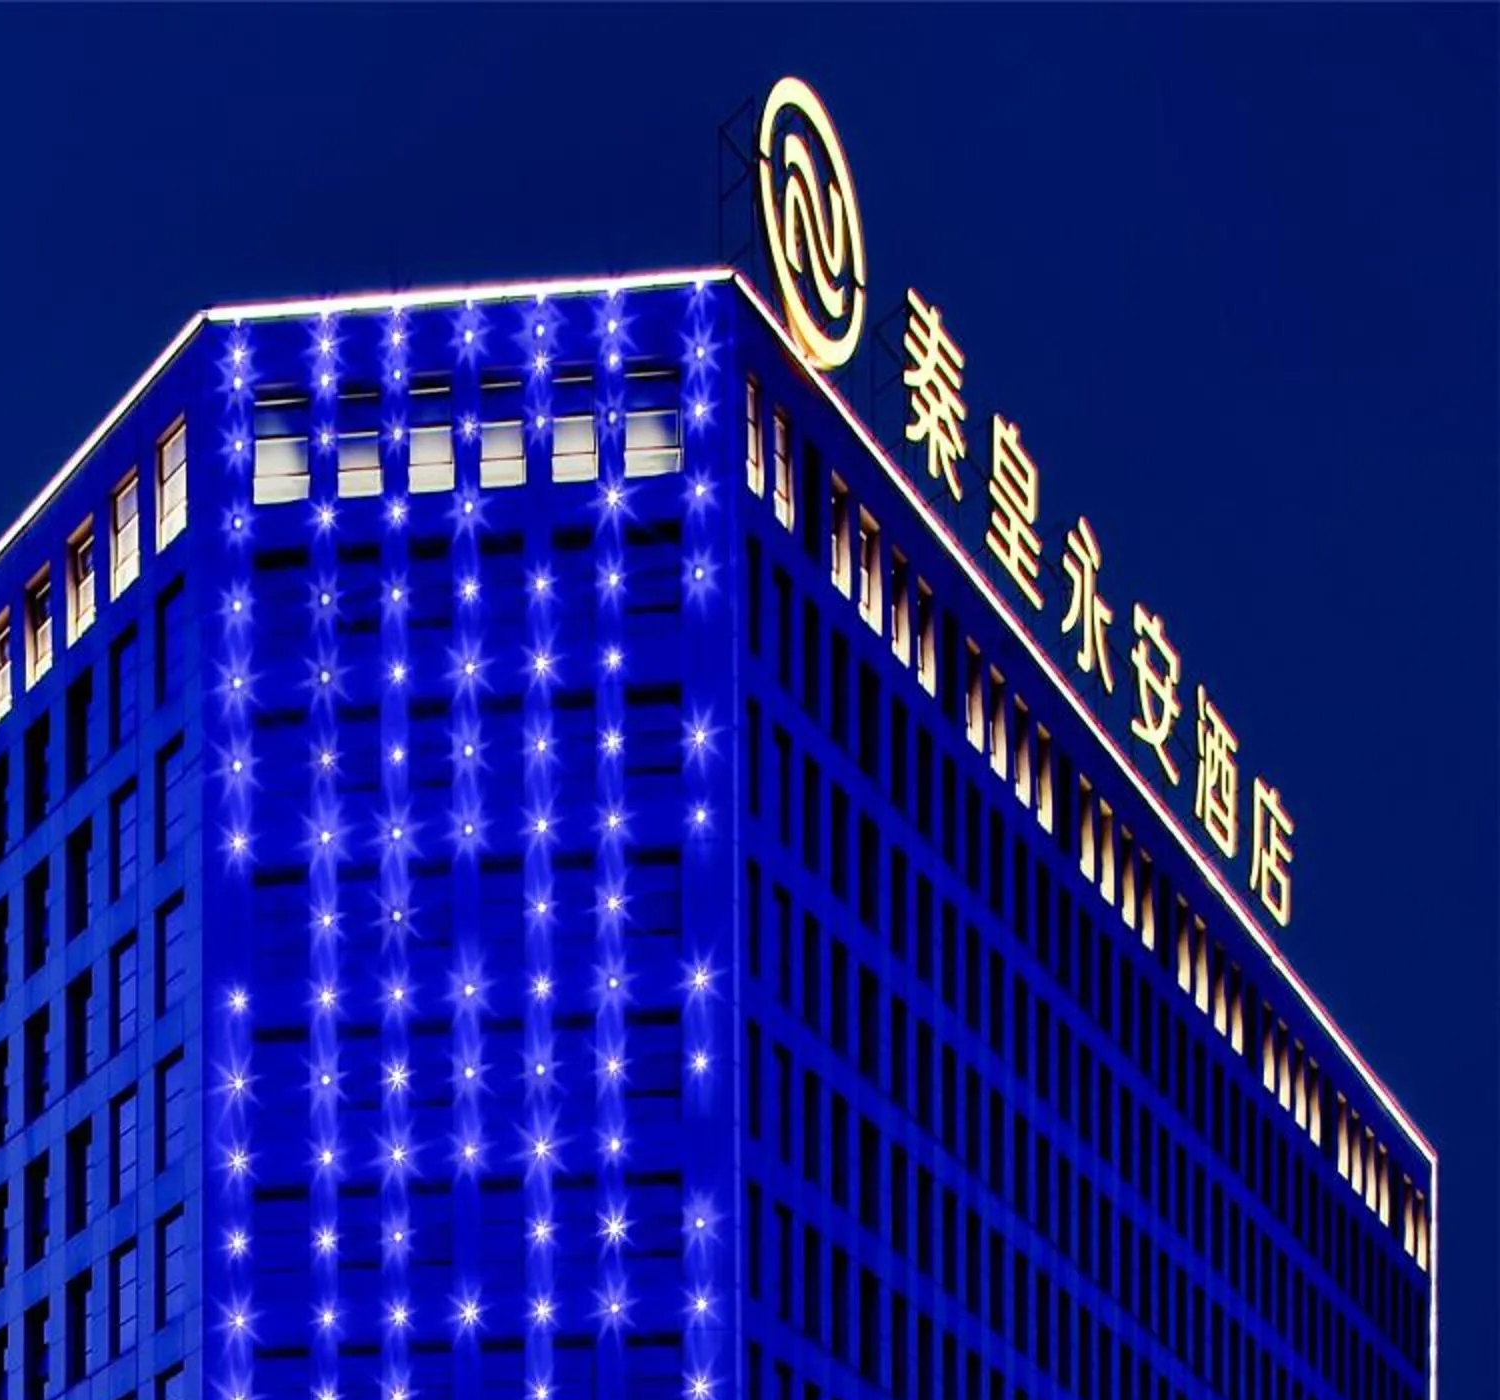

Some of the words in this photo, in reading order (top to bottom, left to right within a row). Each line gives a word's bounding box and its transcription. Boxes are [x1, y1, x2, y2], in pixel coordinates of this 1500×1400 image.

[903, 289, 1293, 928] 秦皇永安酒店
